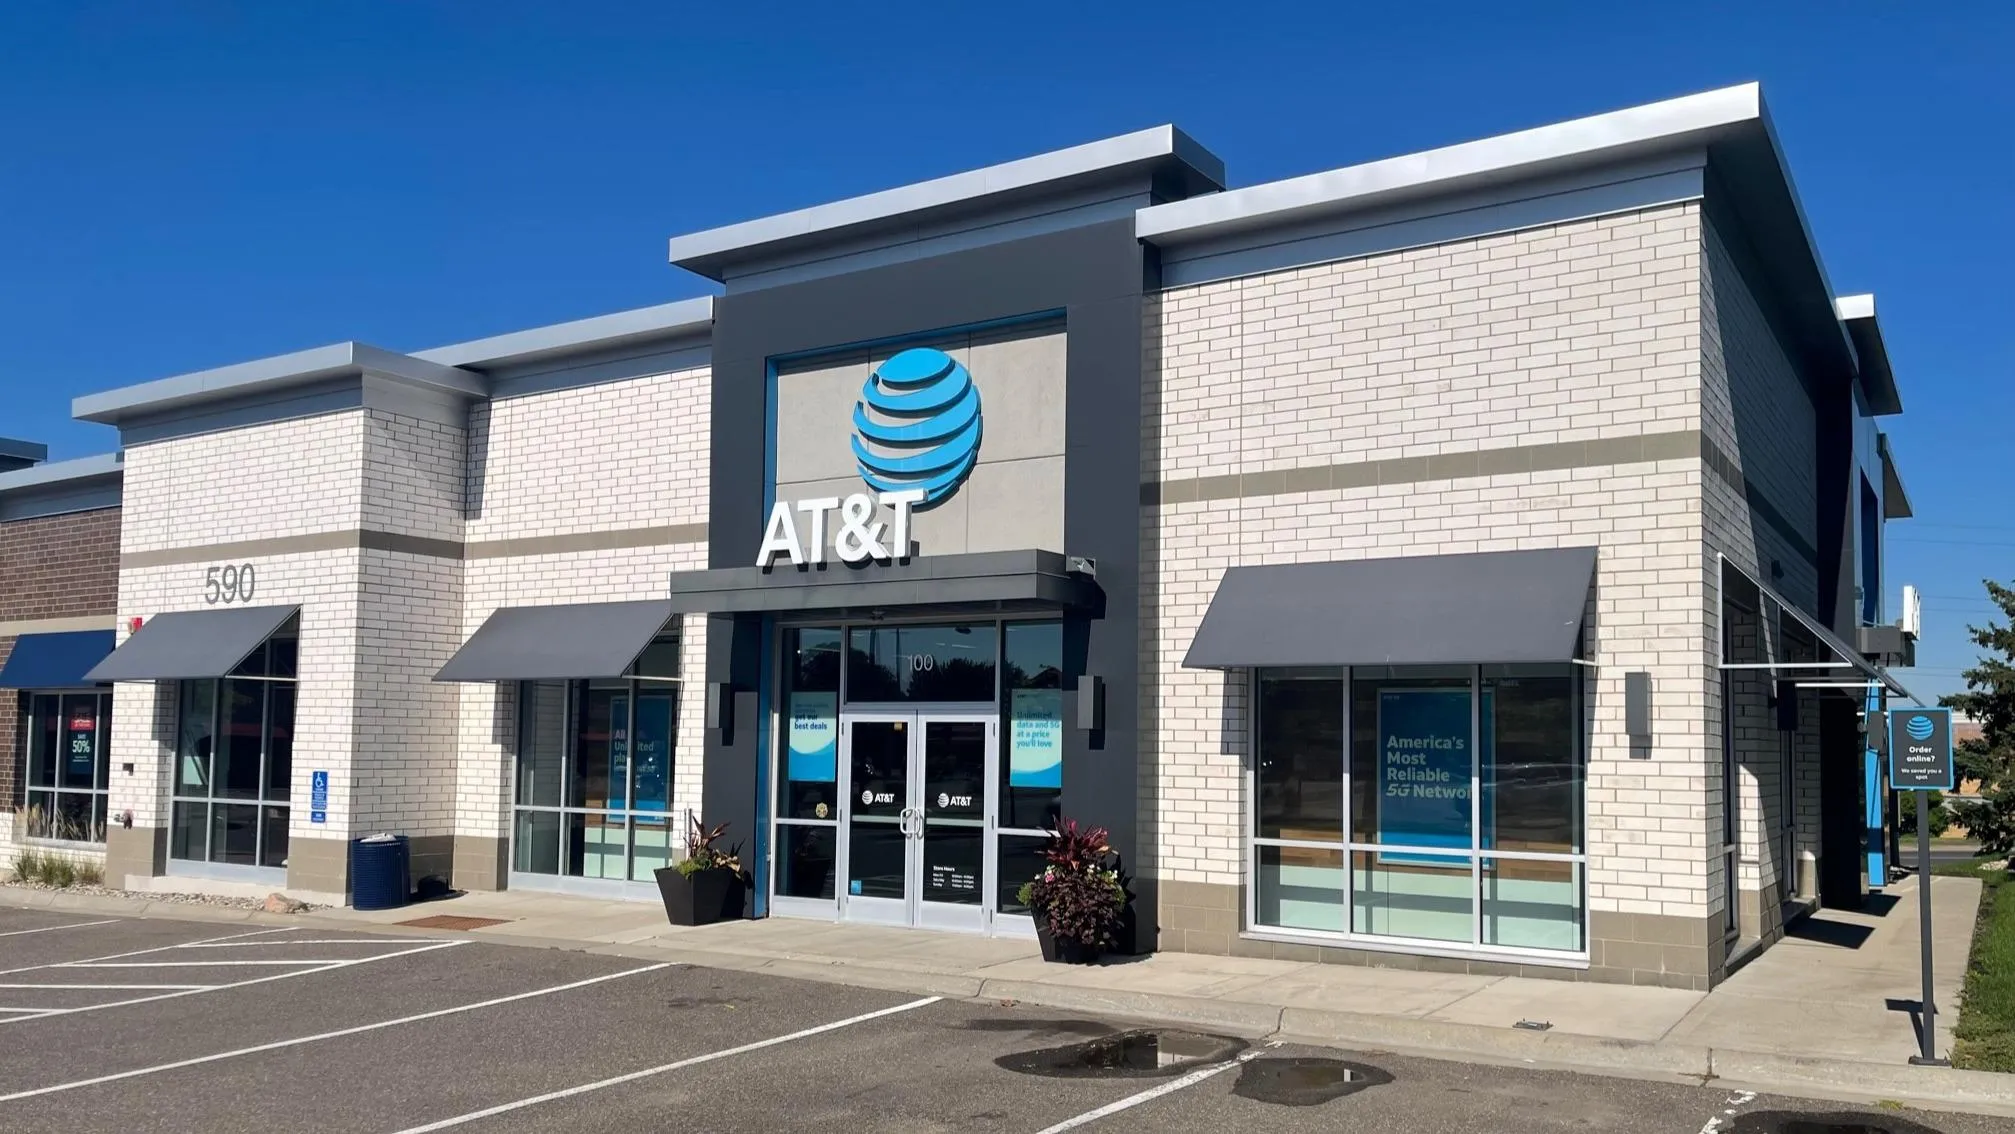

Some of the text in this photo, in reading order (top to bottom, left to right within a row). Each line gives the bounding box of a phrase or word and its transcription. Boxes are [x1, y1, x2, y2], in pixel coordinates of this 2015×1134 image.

[756, 489, 928, 567] AT&T
[205, 563, 255, 605] 590
[908, 654, 934, 671] 100
[795, 722, 828, 730] best deals
[1032, 731, 1050, 740] price
[1386, 734, 1465, 750] America's
[72, 740, 91, 753] 50%
[1038, 740, 1052, 748] love
[1908, 745, 1933, 754] Order
[1387, 751, 1427, 766] Most
[1906, 755, 1936, 763] online?
[1387, 767, 1450, 782] Reliable
[1386, 783, 1478, 800] 5G Networ
[874, 793, 895, 804] AT&T
[950, 796, 972, 807] AT&T
